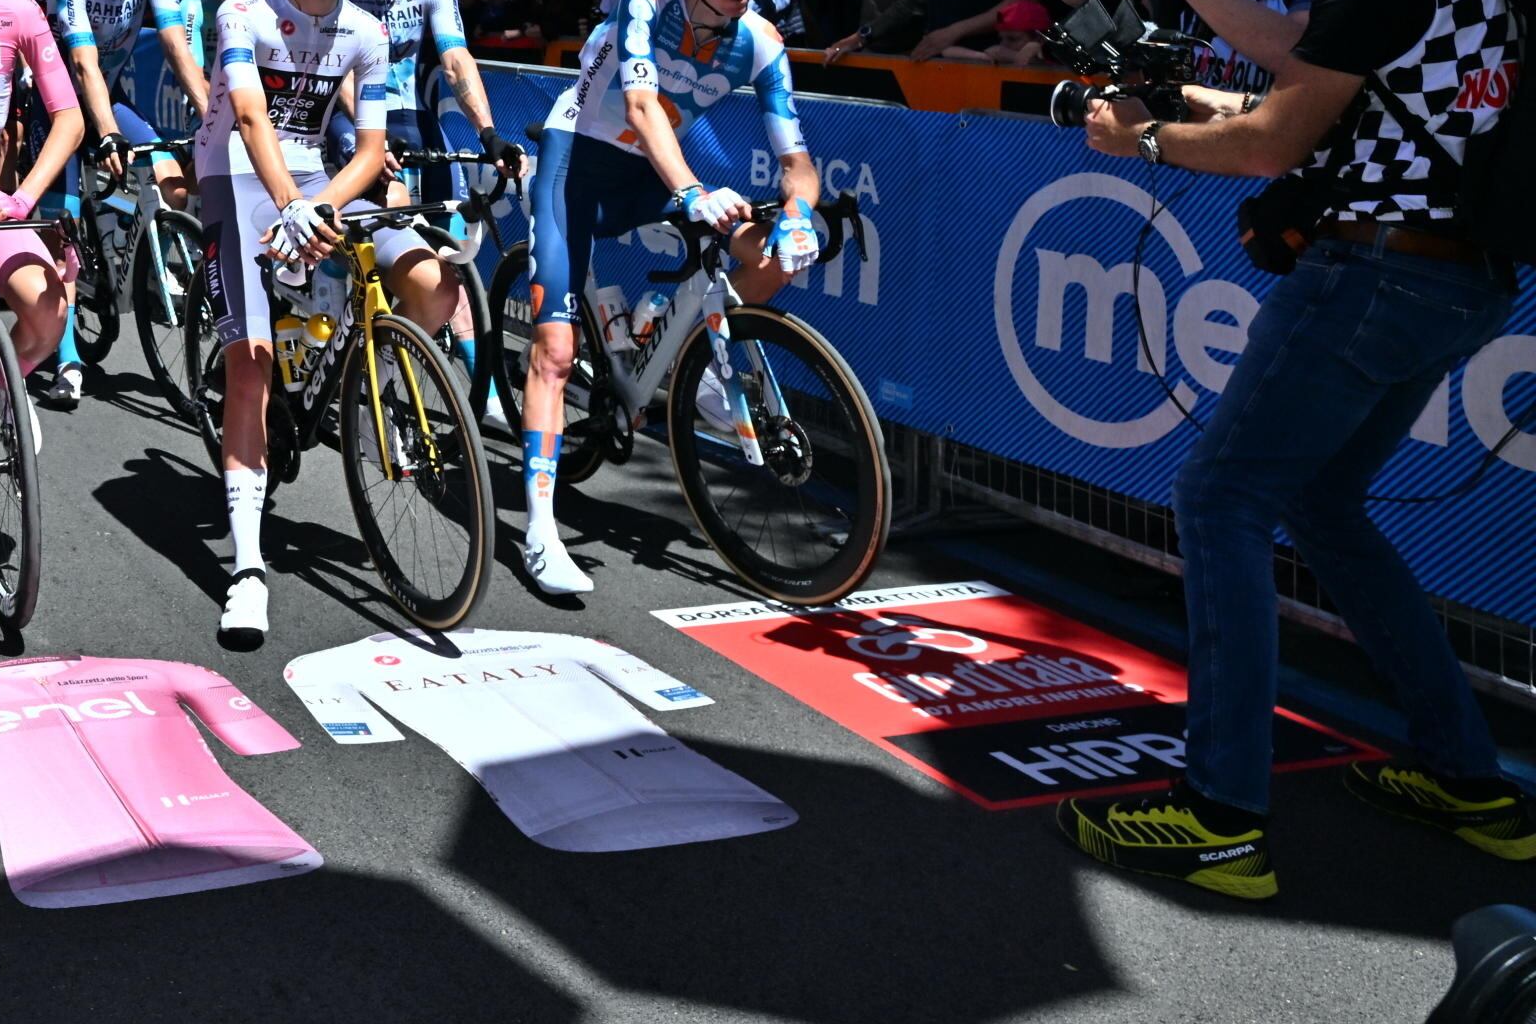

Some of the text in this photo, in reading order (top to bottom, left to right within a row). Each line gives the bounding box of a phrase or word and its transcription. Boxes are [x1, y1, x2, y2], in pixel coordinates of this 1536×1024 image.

[268, 48, 347, 68] EATALY
[290, 77, 334, 97] VISMA
[576, 41, 613, 109] HANS ANDERS
[199, 80, 226, 147] EATALY
[271, 94, 315, 109] lease
[750, 148, 880, 206] BACA
[116, 207, 143, 294] MERIDA
[208, 260, 220, 298] VISMA
[551, 311, 582, 322] SCOTT
[391, 331, 427, 365] RESERVE
[69, 677, 106, 686] Gazzetta
[106, 675, 125, 683] dello
[126, 674, 148, 682] Sport
[383, 663, 560, 692] EATALY
[852, 670, 956, 704] Giro
[911, 683, 1144, 718] 107 AMORE INFINITO
[1046, 717, 1122, 733] DANONE
[990, 729, 1189, 786] HiPR
[189, 791, 230, 802] ITALIA.IT
[1199, 843, 1255, 864] SCARPA
